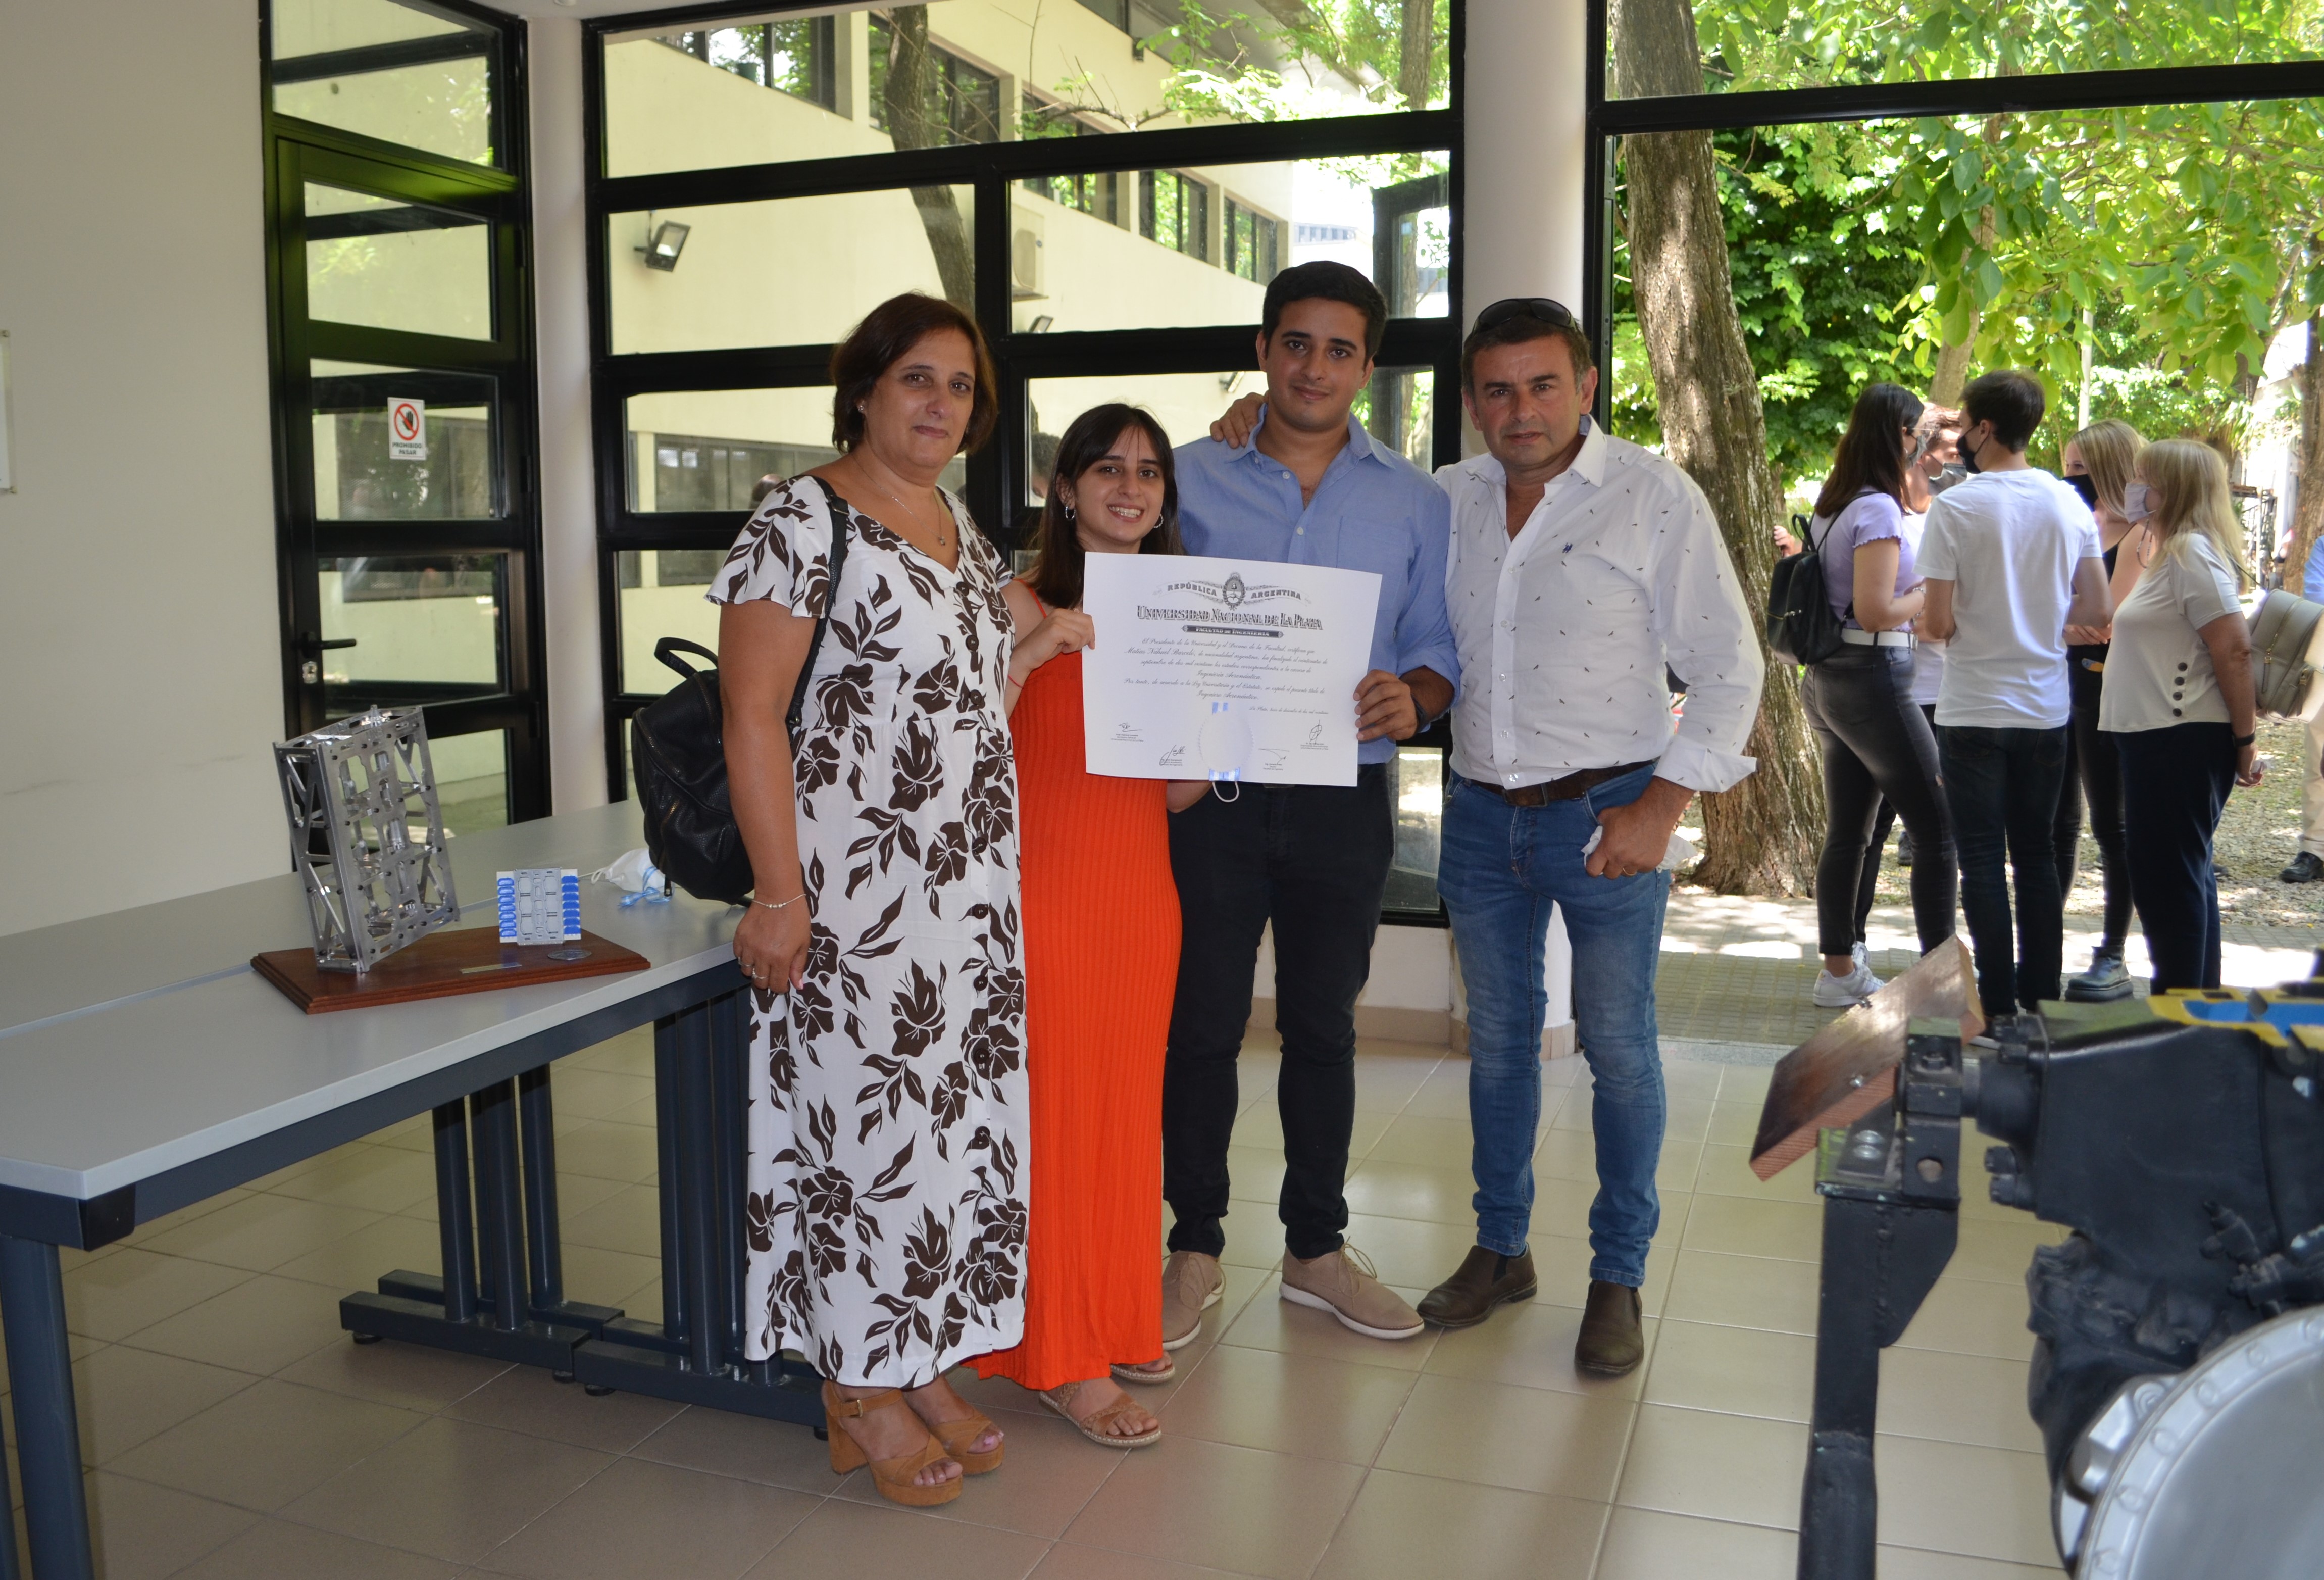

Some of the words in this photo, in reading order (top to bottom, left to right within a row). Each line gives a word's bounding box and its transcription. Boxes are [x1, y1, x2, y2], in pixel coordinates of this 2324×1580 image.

[1167, 582, 1217, 596] REPÚBLICA
[1251, 589, 1301, 600] ARGENTINA
[1137, 605, 1210, 622] UNIVERSIDAD
[1211, 608, 1264, 625] NACIONAL
[1264, 614, 1279, 627] DE
[1280, 613, 1294, 628] LA
[1294, 614, 1324, 631] PLATA
[1269, 655, 1292, 663] finalizado
[1196, 690, 1222, 700] Ingeniero
